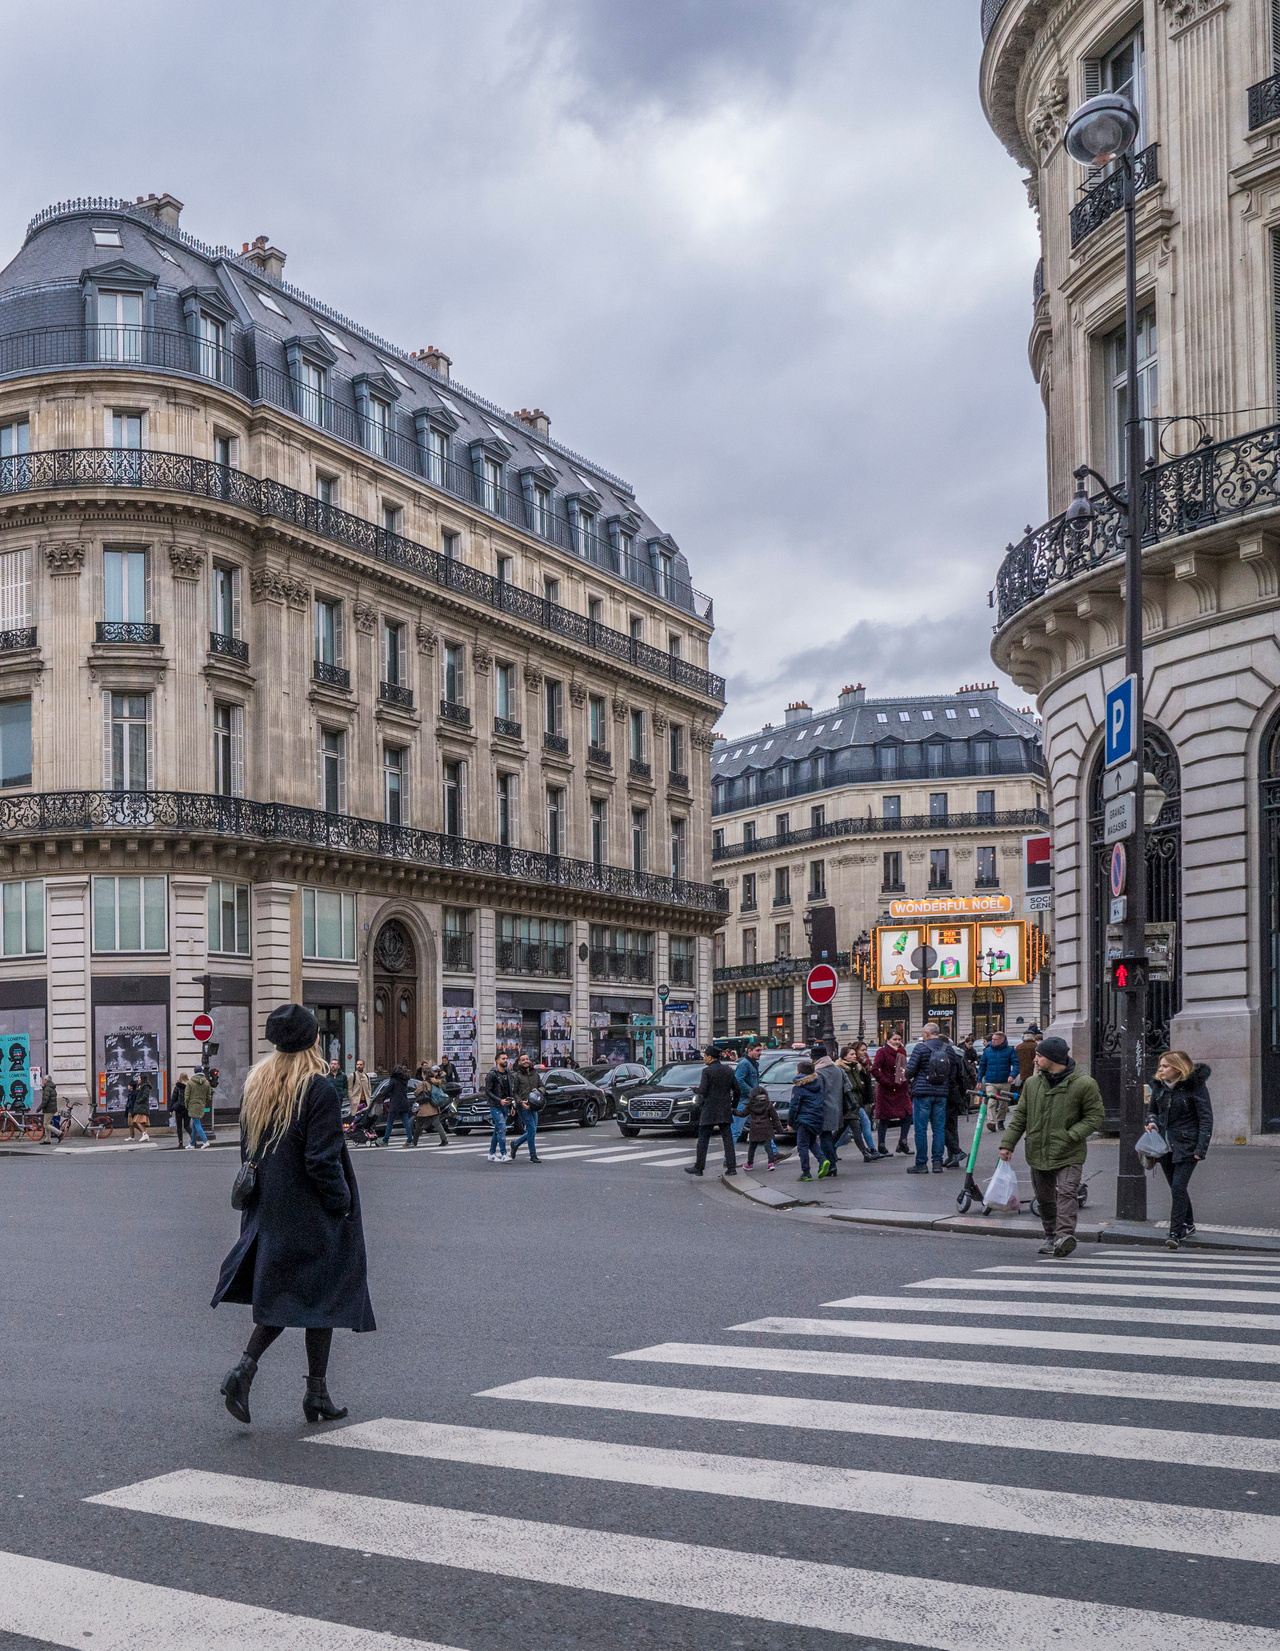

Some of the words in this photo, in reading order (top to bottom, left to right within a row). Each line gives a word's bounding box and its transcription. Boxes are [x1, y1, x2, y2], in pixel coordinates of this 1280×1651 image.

[1112, 698, 1125, 750] P
[1109, 804, 1126, 820] GRANDS
[1107, 819, 1128, 837] MAGASINS
[895, 901, 969, 914] WONDERFUL
[972, 898, 1004, 910] NOËL
[928, 1009, 954, 1017] Orange
